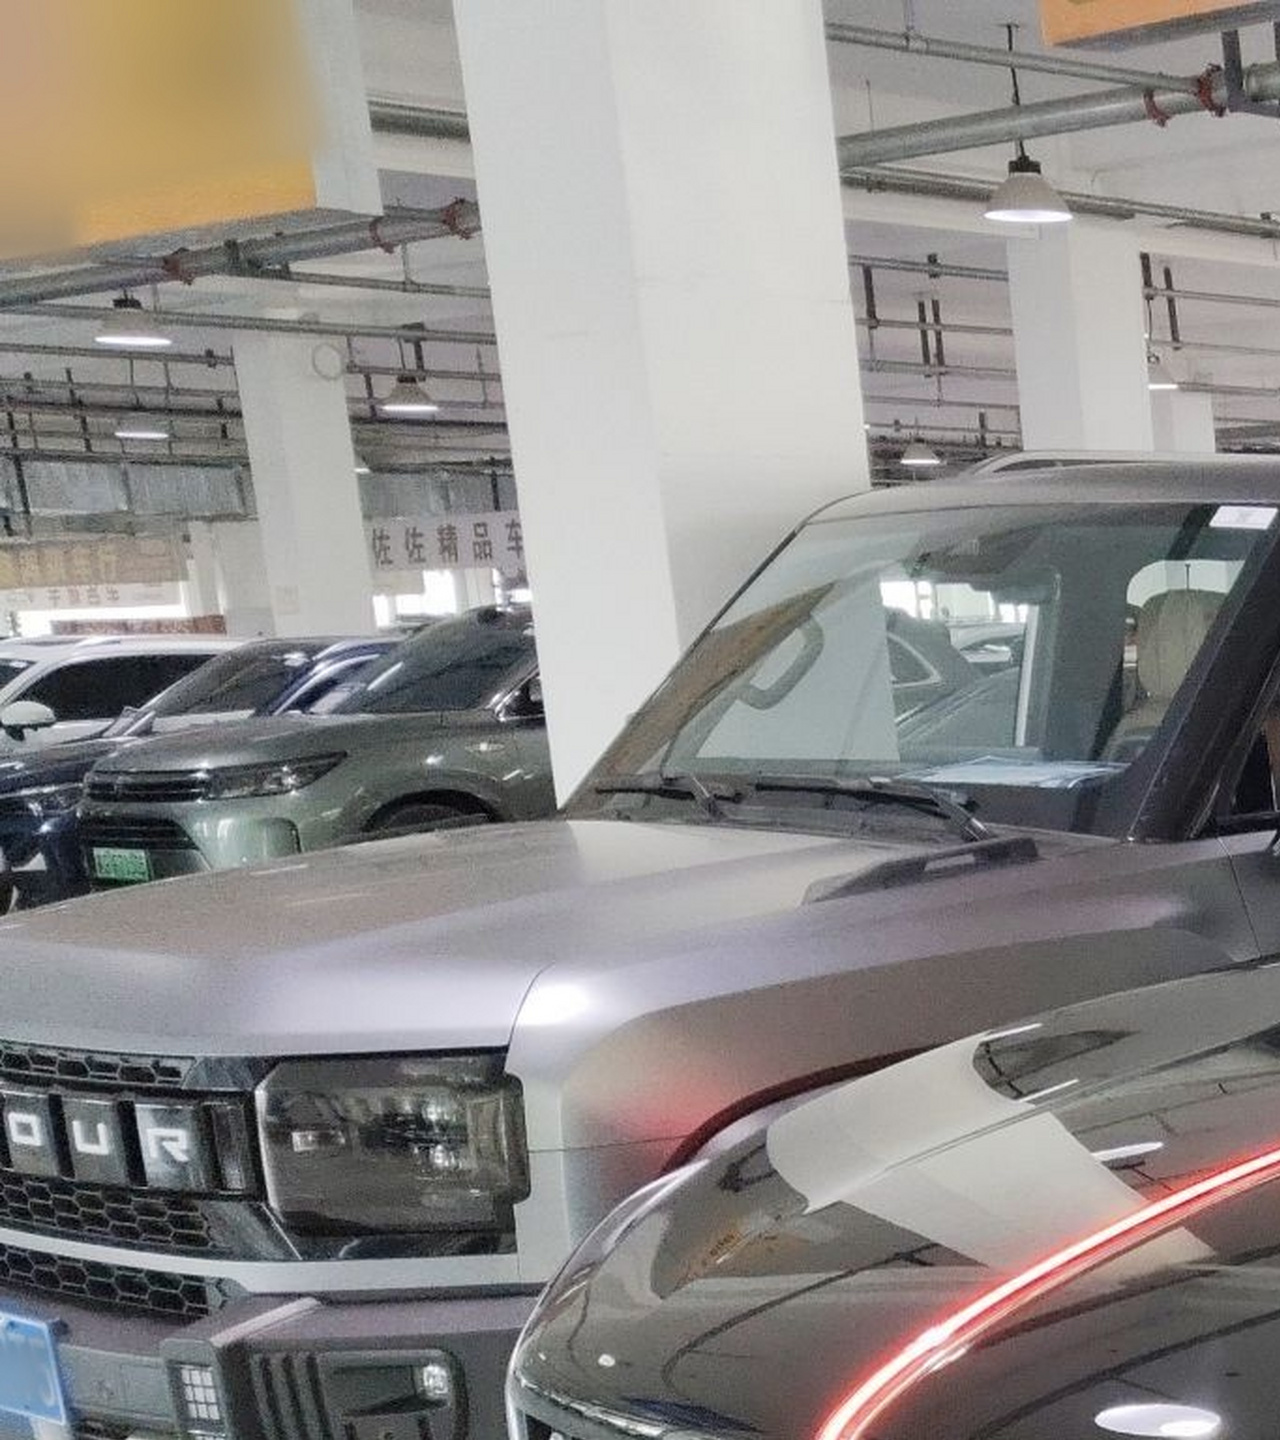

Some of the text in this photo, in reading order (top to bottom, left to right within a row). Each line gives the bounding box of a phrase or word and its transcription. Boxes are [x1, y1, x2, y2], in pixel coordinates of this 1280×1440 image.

[372, 519, 524, 567] 佐佐精品车
